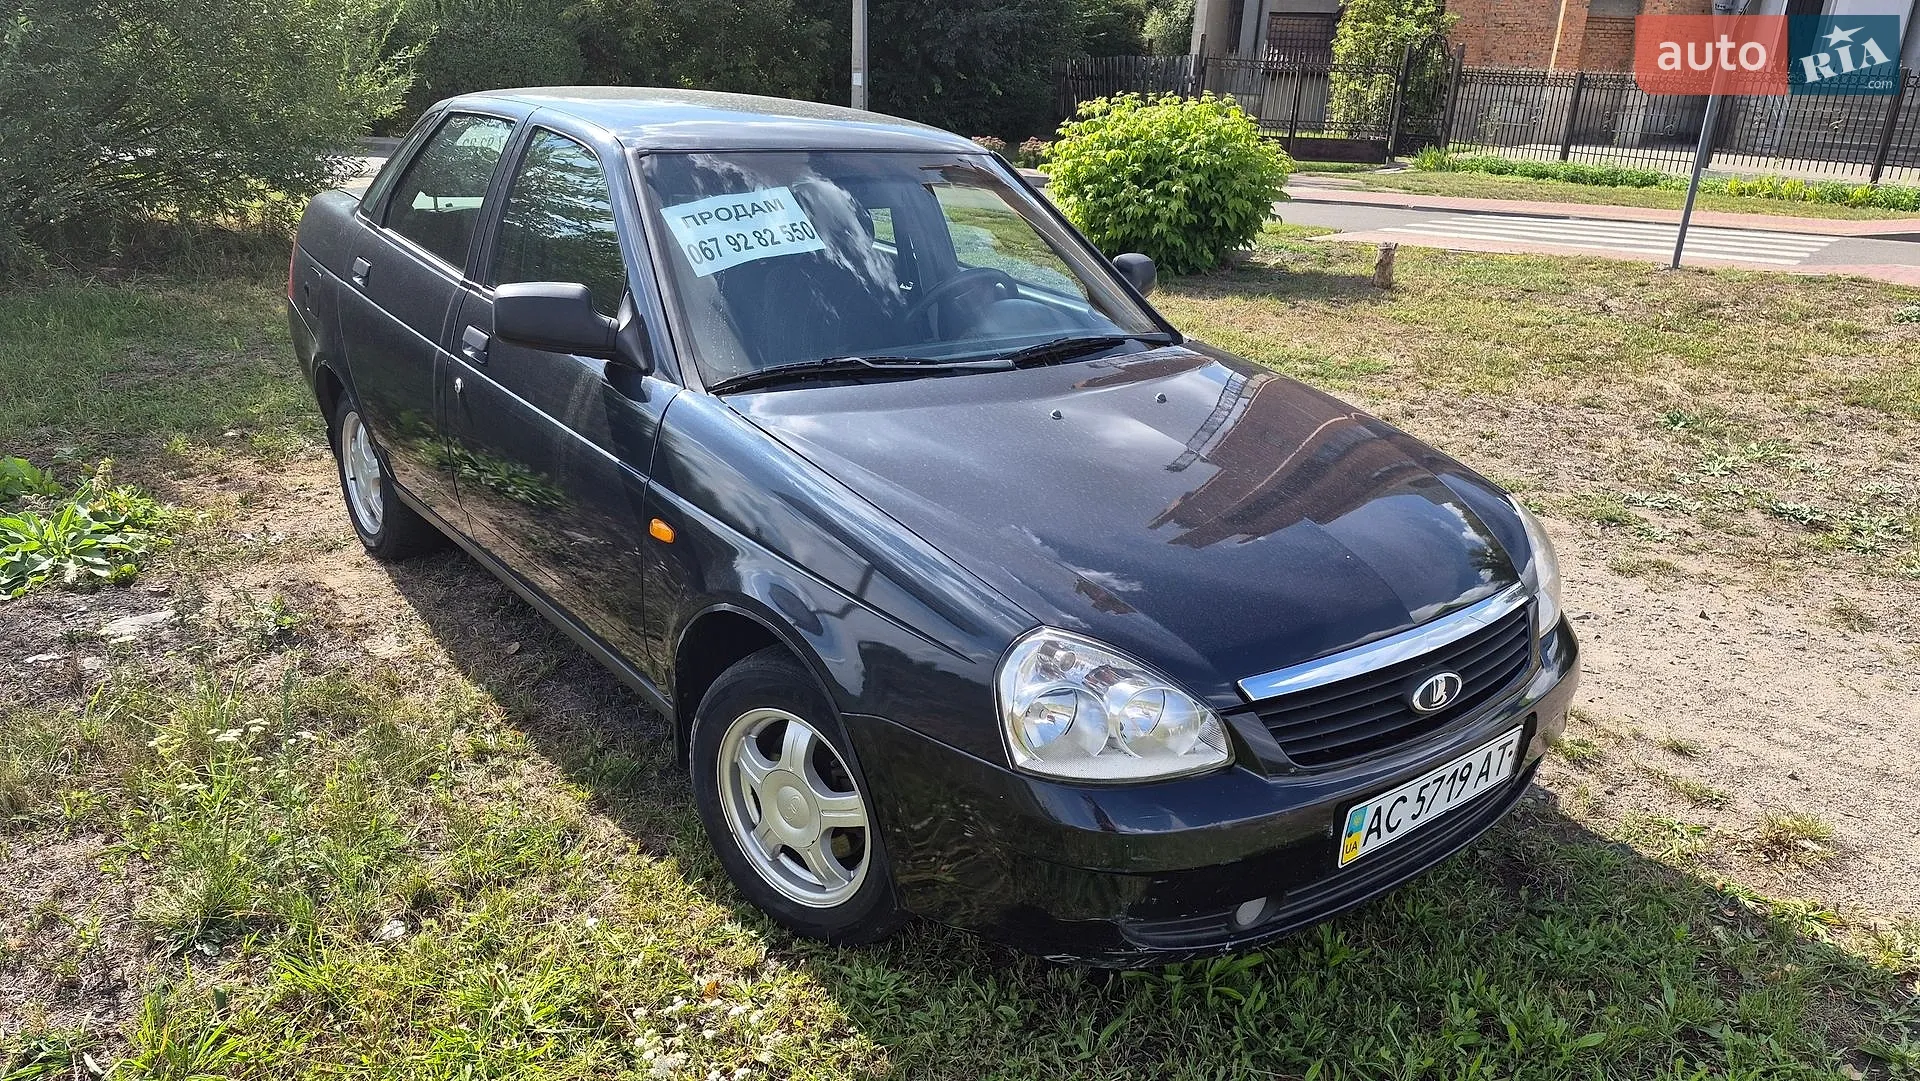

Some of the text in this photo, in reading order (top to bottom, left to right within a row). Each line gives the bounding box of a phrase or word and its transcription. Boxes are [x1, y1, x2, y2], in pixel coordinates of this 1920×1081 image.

[681, 198, 785, 229] ПРОДАМ
[687, 220, 816, 265] 067 92 82 550
[1362, 795, 1408, 848] AC
[1411, 761, 1472, 821] 5719
[1345, 840, 1358, 855] UA
